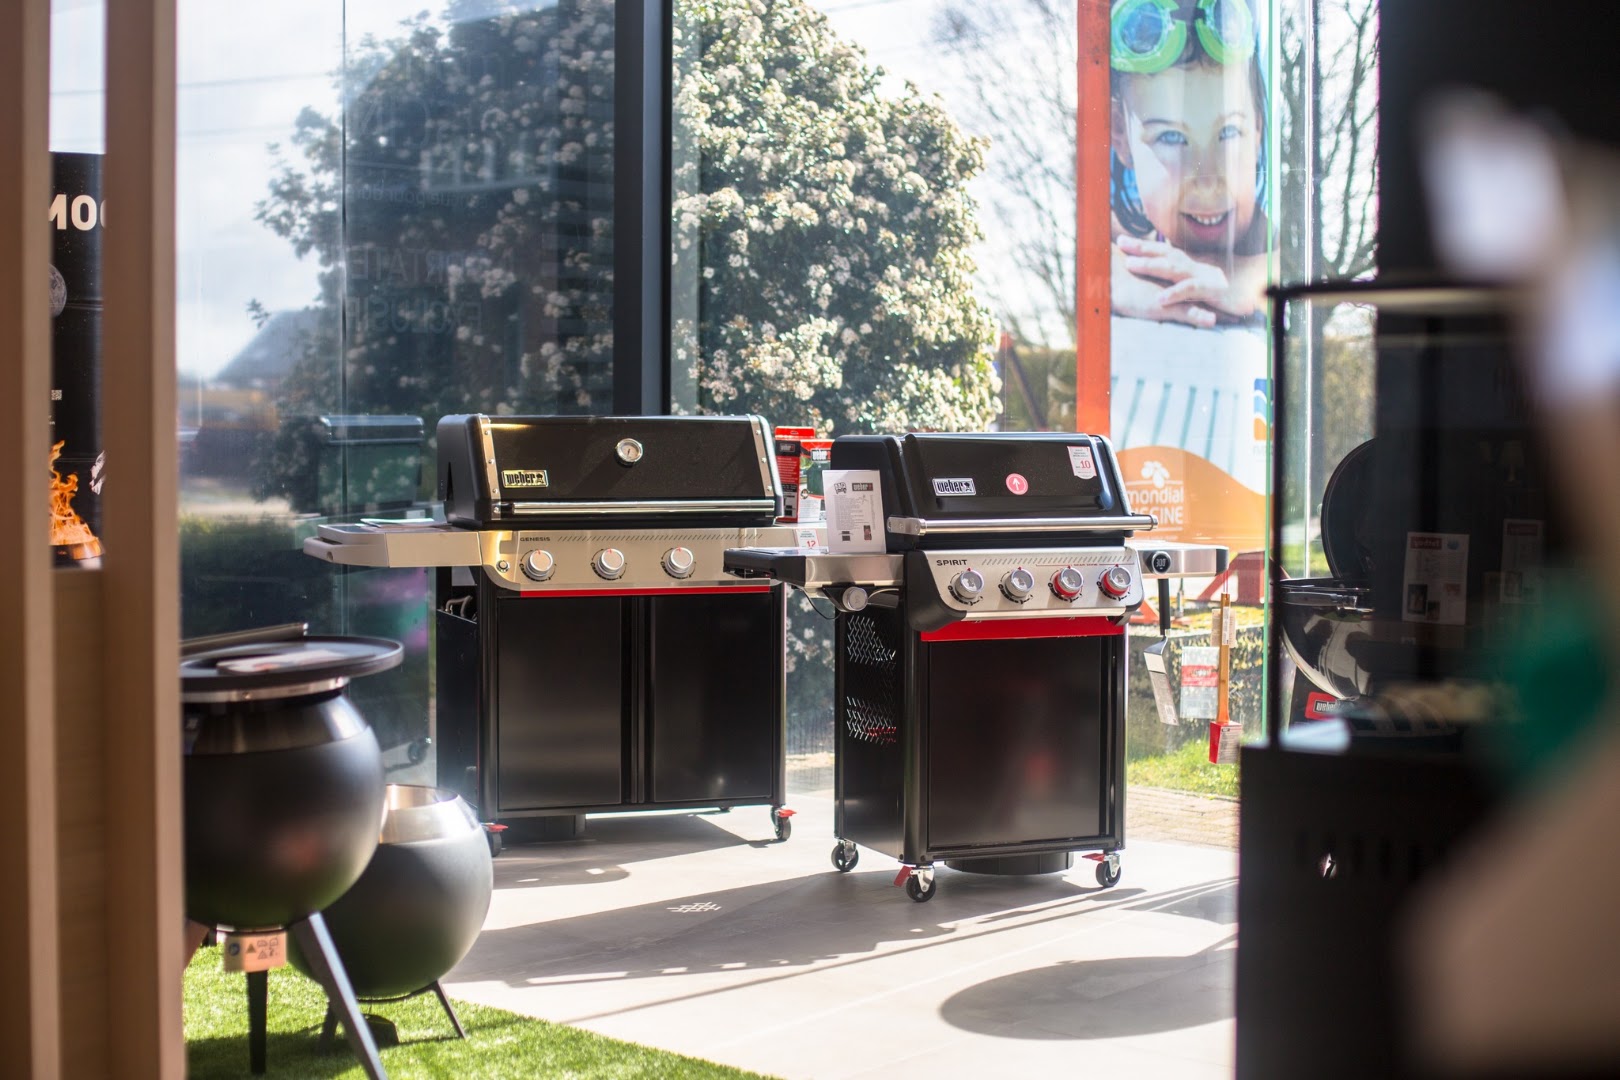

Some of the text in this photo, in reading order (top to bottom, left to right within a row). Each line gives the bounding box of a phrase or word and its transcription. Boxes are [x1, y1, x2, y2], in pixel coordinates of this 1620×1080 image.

[49, 194, 106, 231] MO
[1080, 460, 1091, 468] 10
[505, 471, 536, 485] weber
[936, 480, 963, 494] weber
